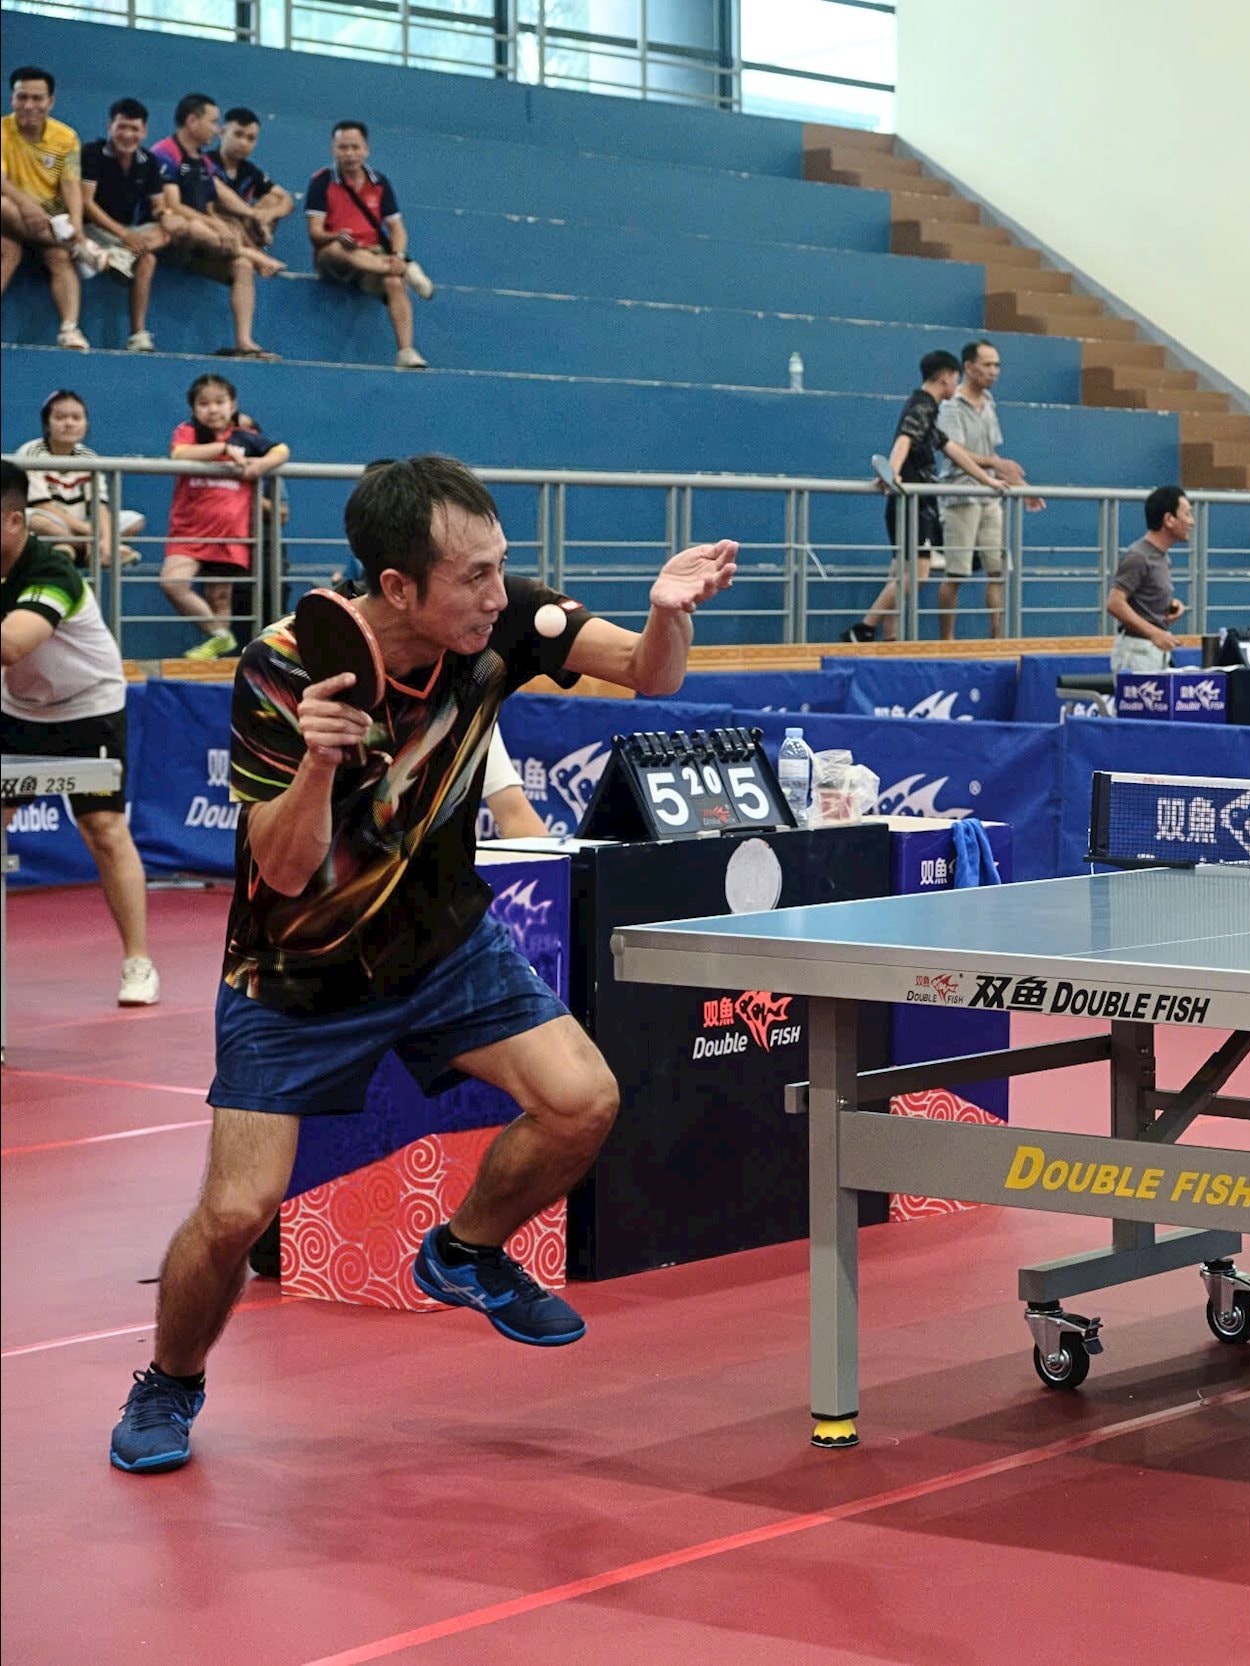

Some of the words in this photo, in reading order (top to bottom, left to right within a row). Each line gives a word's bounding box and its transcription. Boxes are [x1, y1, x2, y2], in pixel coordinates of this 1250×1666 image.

[45, 777, 76, 793] 235
[647, 772, 689, 826] 5
[728, 767, 770, 820] 5
[947, 995, 964, 1004] FISH
[1050, 981, 1150, 1020] DOUBLE
[1151, 994, 1211, 1023] FISH
[692, 1031, 749, 1060] Double
[769, 1025, 801, 1048] FISH
[1004, 1145, 1166, 1200] DOUBLE
